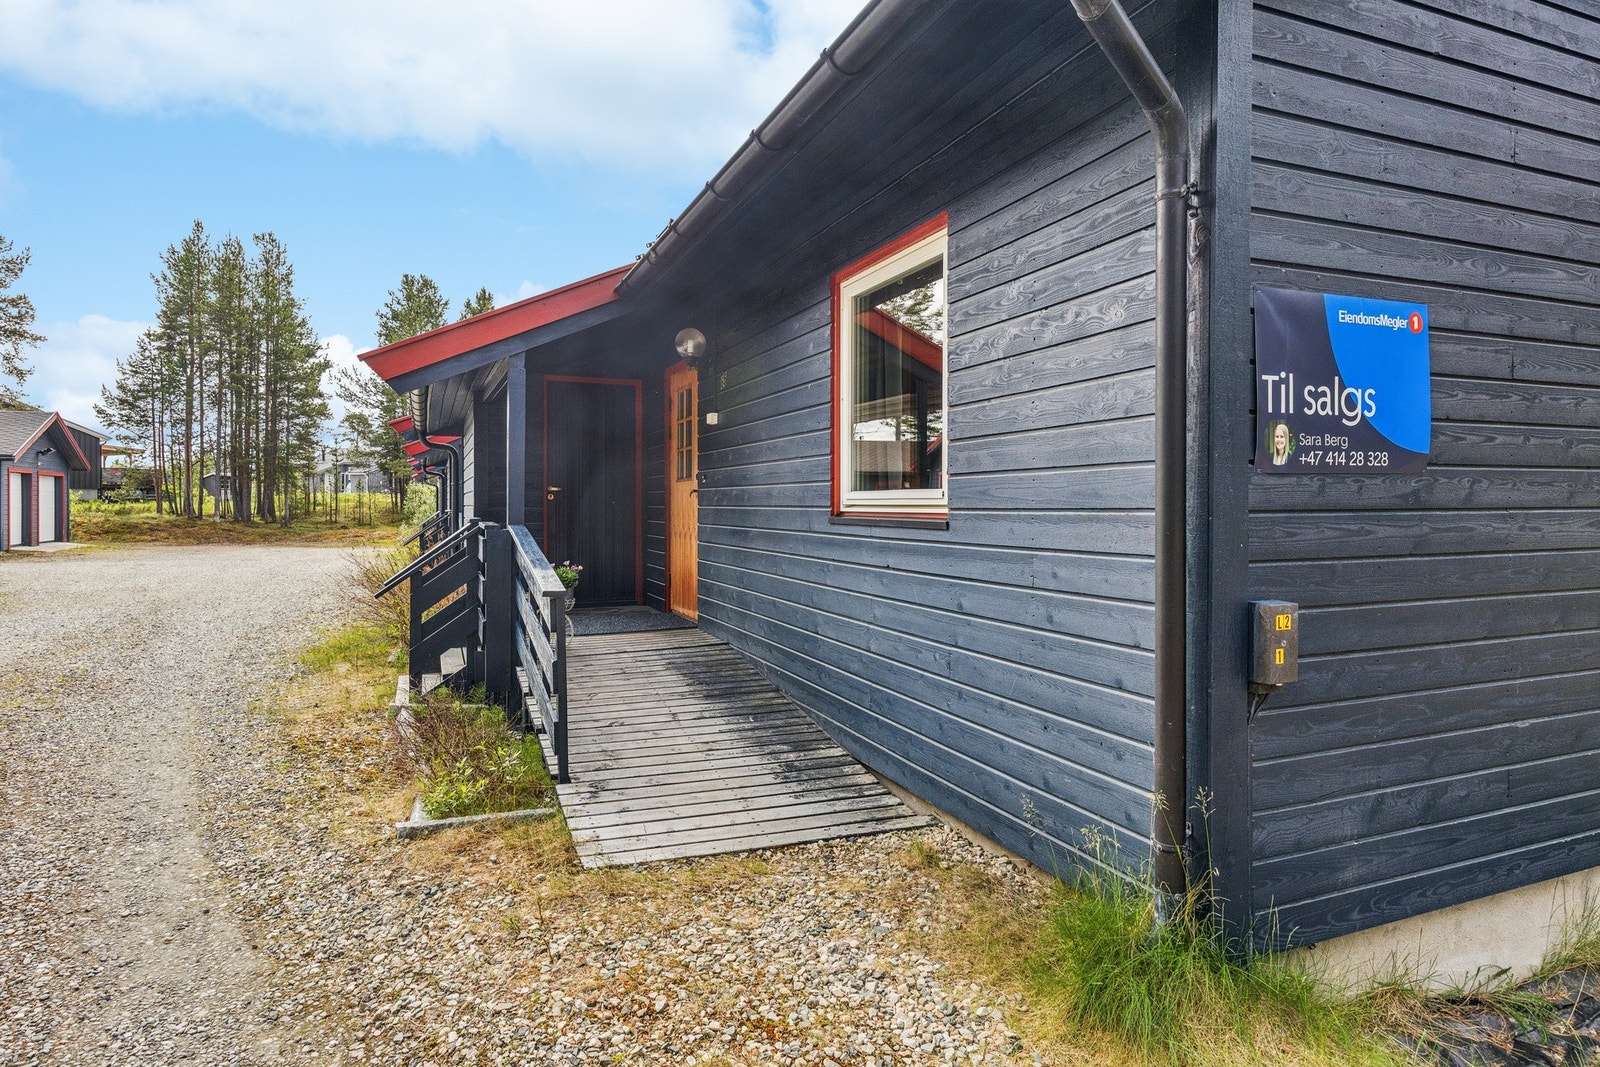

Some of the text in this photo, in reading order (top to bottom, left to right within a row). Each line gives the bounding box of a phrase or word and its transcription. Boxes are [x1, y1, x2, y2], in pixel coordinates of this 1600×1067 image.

[1338, 309, 1408, 331] EiendomsMegler
[1261, 371, 1377, 427] Til salgs
[1299, 433, 1349, 449] Sara Berg
[1299, 450, 1389, 466] +47 414 28 328
